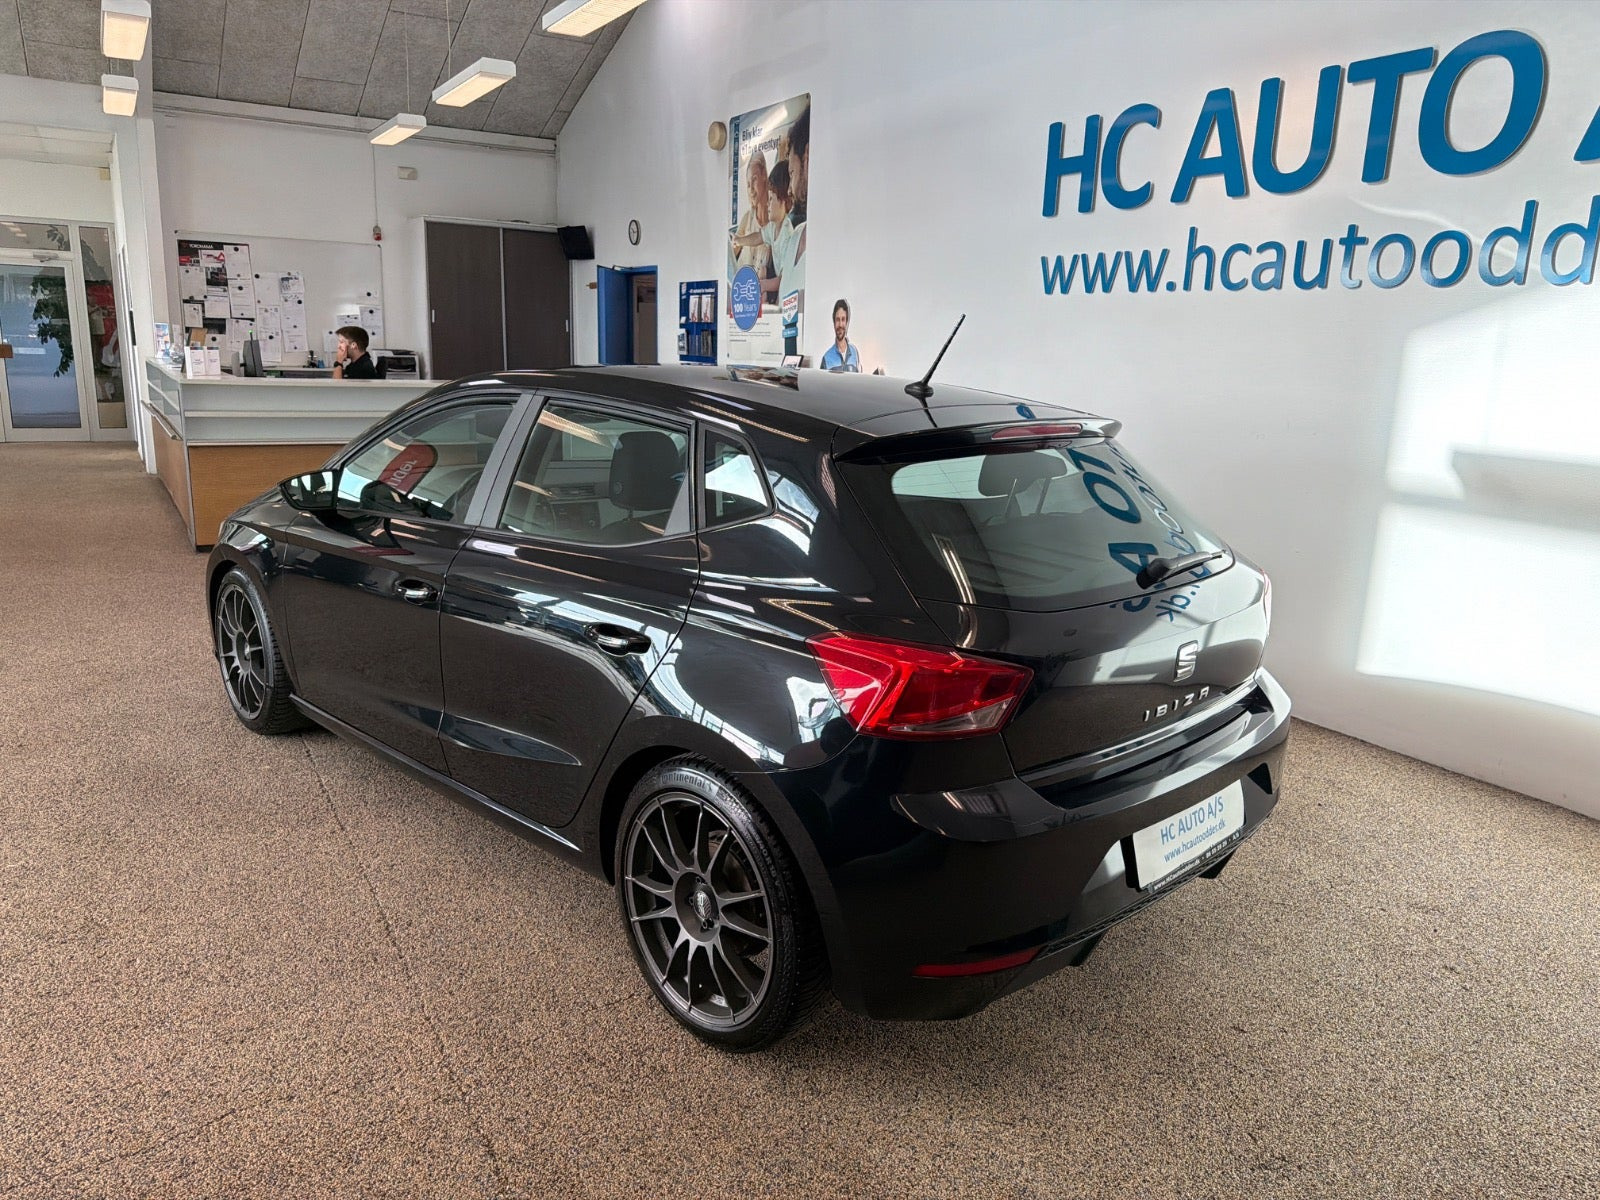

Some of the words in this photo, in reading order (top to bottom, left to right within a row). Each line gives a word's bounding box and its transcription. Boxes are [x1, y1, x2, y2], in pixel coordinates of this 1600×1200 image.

[1042, 103, 1160, 217] HC
[1170, 30, 1548, 203] AUTO
[734, 303, 744, 313] 100
[1144, 686, 1210, 722] IBIZA
[661, 771, 706, 789] Continental
[1160, 823, 1176, 845] HC
[1178, 807, 1206, 836] AUTO
[1207, 796, 1224, 819] A/S
[1163, 819, 1226, 863] www.hcautoodder.dk
